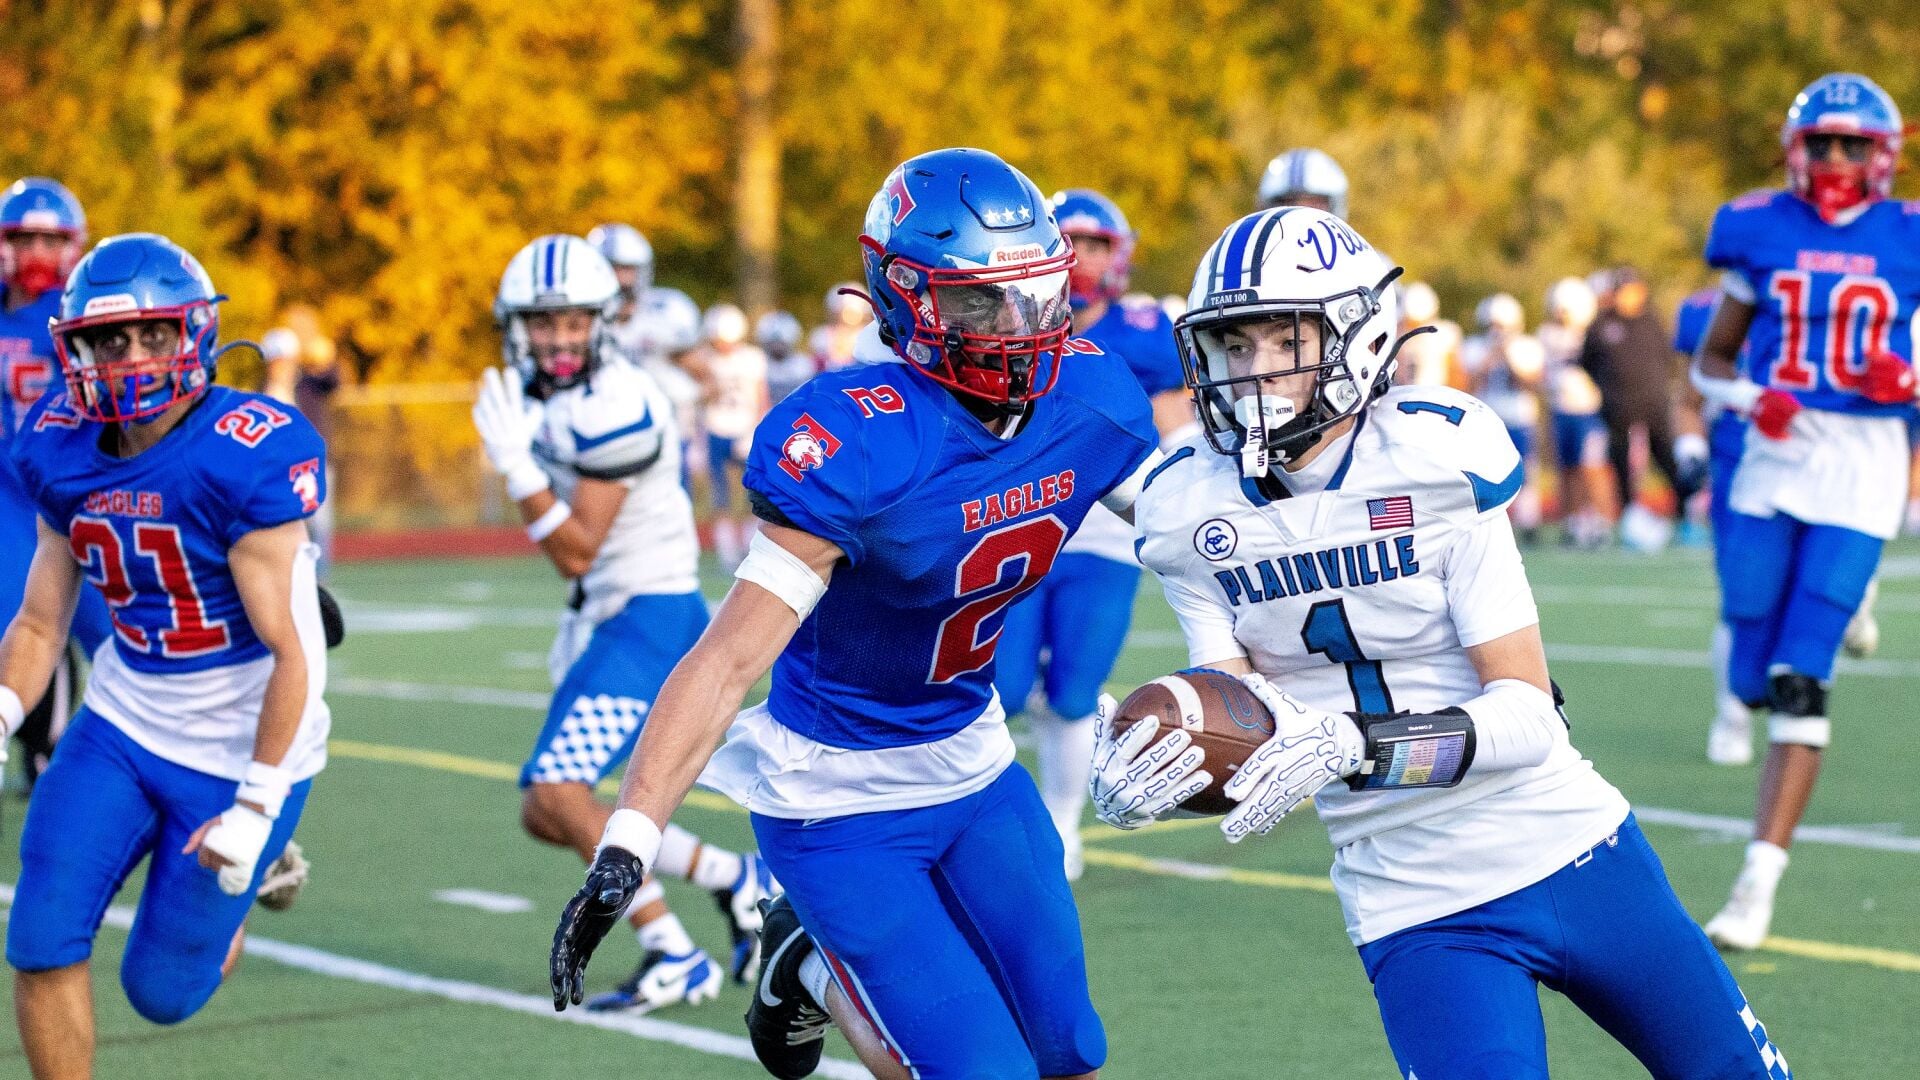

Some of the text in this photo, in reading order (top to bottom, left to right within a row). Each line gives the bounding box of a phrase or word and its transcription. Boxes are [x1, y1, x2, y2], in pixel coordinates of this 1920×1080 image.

[996, 248, 1042, 263] Riddell
[1210, 292, 1248, 306] TEAM 100
[1768, 269, 1899, 392] 10
[214, 399, 292, 449] 21
[842, 384, 905, 418] 2
[1397, 400, 1466, 426] 1
[84, 488, 163, 519] EAGLES
[961, 469, 1075, 533] EAGLES
[69, 513, 232, 658] 21
[924, 512, 1069, 685] 2
[1214, 534, 1420, 607] PLAINVILLE
[1300, 597, 1395, 713] 1
